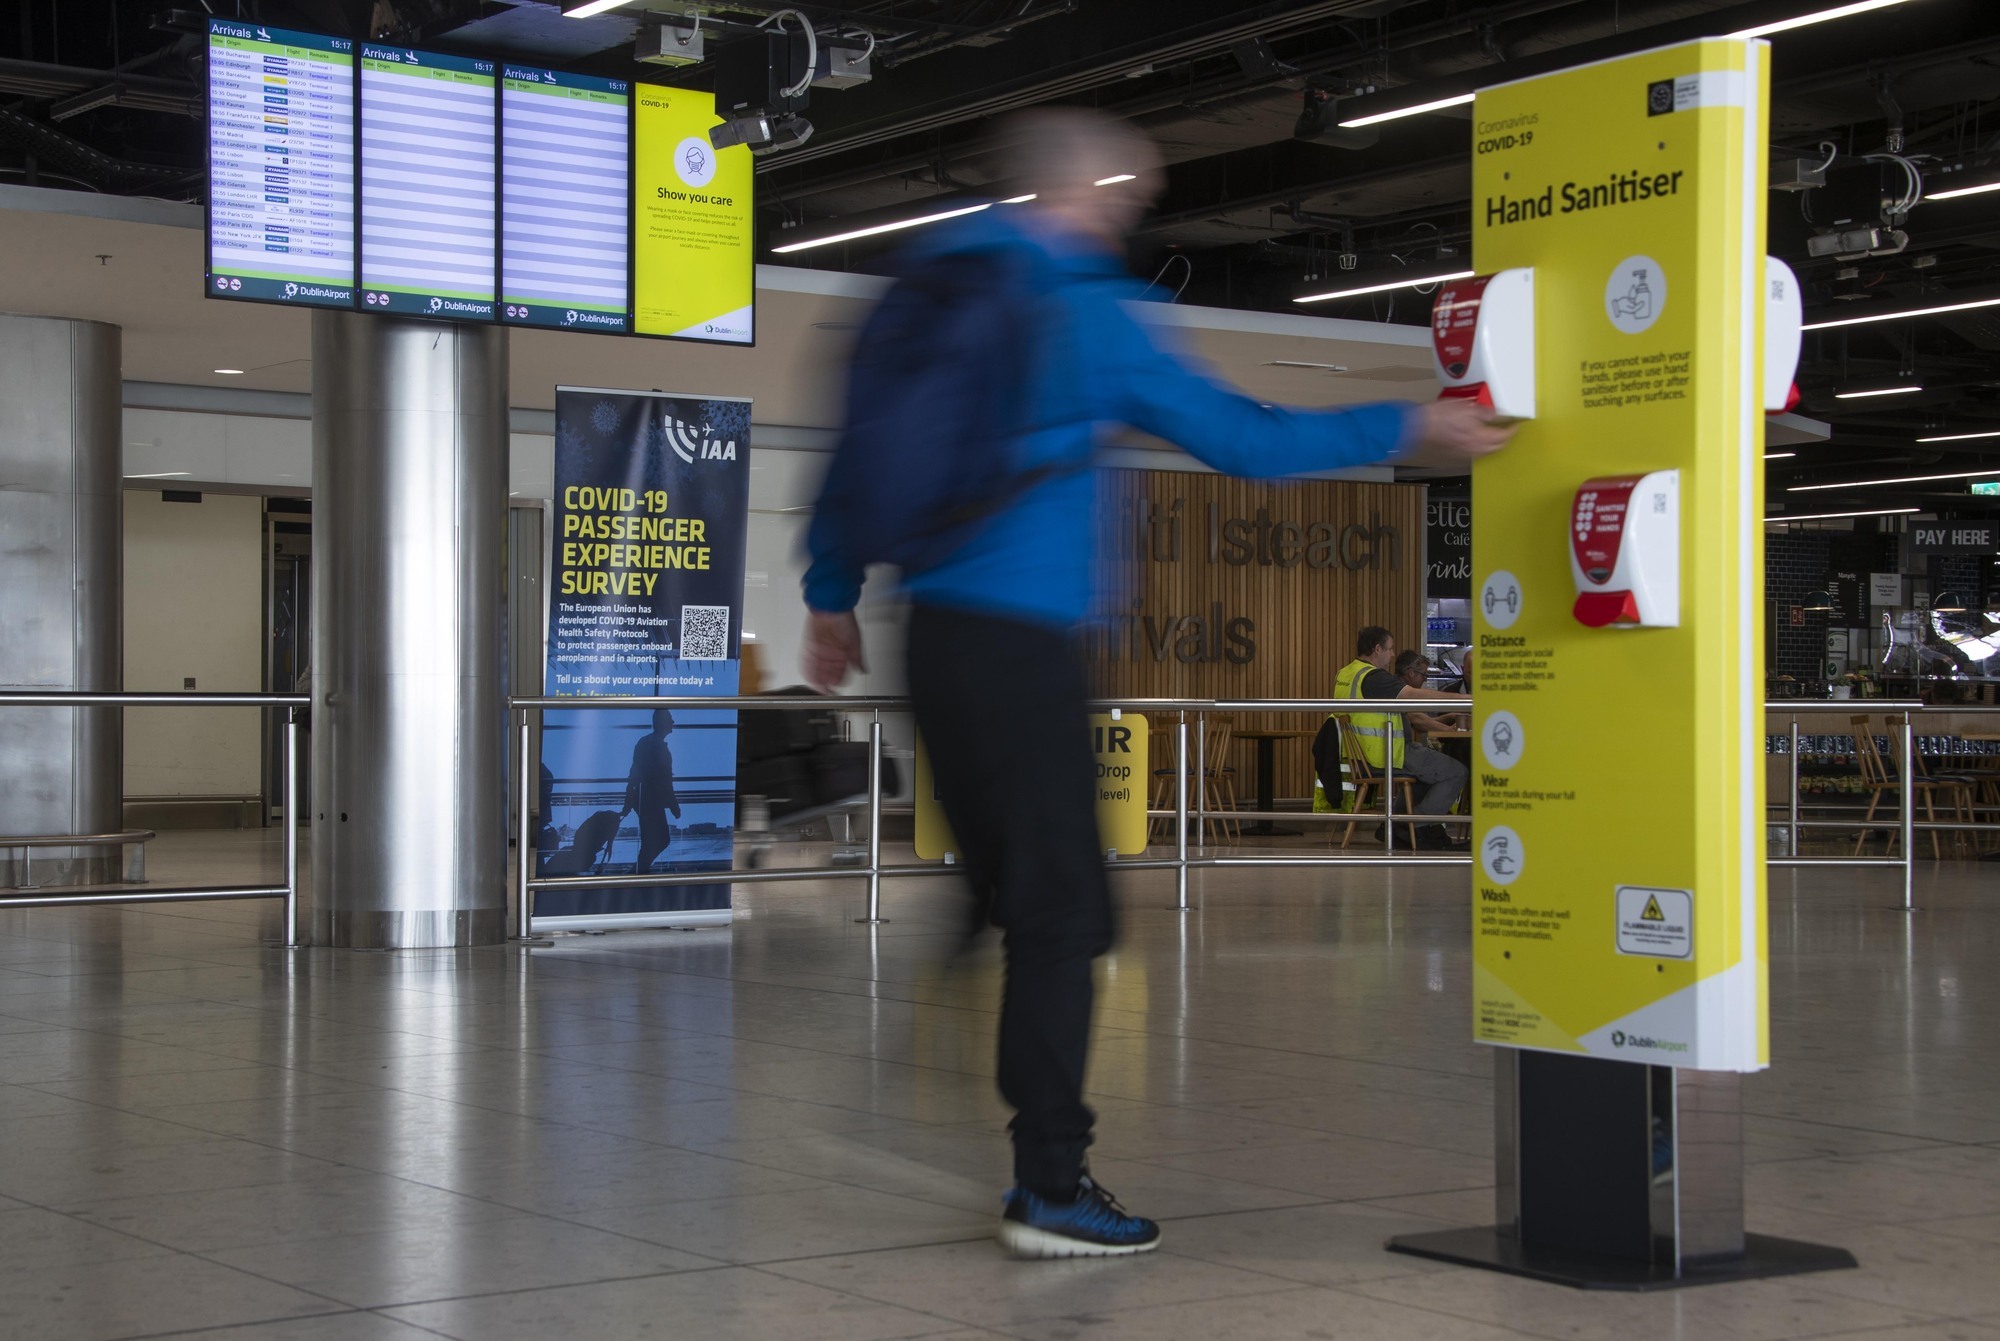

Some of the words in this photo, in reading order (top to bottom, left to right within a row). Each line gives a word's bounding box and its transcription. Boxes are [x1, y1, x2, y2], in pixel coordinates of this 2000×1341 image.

[211, 24, 252, 39] Arrivals
[331, 40, 352, 50] 15:17
[363, 48, 401, 61] Arrivals
[226, 60, 251, 70] Edinburgh
[474, 62, 493, 72] 15:17
[226, 71, 251, 80] Barcelona
[504, 68, 540, 82] Arrivals
[226, 81, 240, 89] Kerry
[608, 82, 627, 91] 15:17
[640, 99, 670, 109] COVID-19
[1477, 113, 1540, 135] Coronavirus
[1477, 131, 1534, 155] COVID-19
[657, 187, 686, 201] Show
[689, 193, 708, 204] you
[710, 195, 733, 206] care
[1486, 185, 1553, 228] Hand
[1560, 169, 1684, 213] Sanitiser
[300, 286, 350, 300] DublinAirport
[444, 301, 491, 314] DublinAirport
[579, 313, 623, 326] DublinAirport
[1589, 362, 1606, 372] you
[1607, 356, 1640, 368] cannot
[1641, 352, 1666, 364] wash
[1667, 351, 1691, 362] your
[1612, 369, 1642, 380] please
[1644, 367, 1662, 377] use
[1663, 362, 1689, 374] hand
[1582, 384, 1618, 396] sanitiser
[1620, 380, 1651, 392] before
[1652, 380, 1664, 388] or
[1665, 376, 1689, 387] after
[1583, 396, 1623, 408] touching
[1625, 395, 1642, 404] any
[701, 440, 737, 460] IAA
[564, 486, 668, 513] COVID-19
[1427, 501, 1470, 528] ette
[563, 514, 706, 542] PASSENGER
[1207, 500, 1400, 571] Isteach
[1444, 531, 1470, 546] Café
[1915, 530, 1946, 545] PAY
[1951, 529, 1990, 545] HERE
[562, 542, 711, 570] EXPERIENCE
[561, 570, 659, 596] SURVEY
[559, 603, 574, 612] The
[575, 603, 612, 616] European
[613, 604, 637, 613] Union
[638, 604, 652, 613] has
[558, 615, 597, 627] developed
[599, 616, 635, 626] COVID-19
[636, 617, 668, 626] Aviation
[558, 628, 583, 637] Health
[584, 628, 610, 639] Safety
[613, 629, 649, 638] Protocols
[557, 641, 566, 649] to
[567, 641, 595, 651] protect
[596, 643, 640, 653] passengers
[641, 642, 673, 651] onboard
[1480, 634, 1526, 648] Distance
[556, 654, 599, 663] aeroplanes
[600, 654, 616, 662] and
[617, 654, 625, 662] in
[626, 654, 658, 665] airports.
[556, 674, 571, 683] Tell
[572, 676, 582, 684] us
[584, 674, 610, 684] about
[612, 677, 632, 686] your
[633, 676, 678, 686] experience
[679, 675, 704, 687] today
[705, 676, 714, 685] at
[1096, 763, 1131, 781] Drop
[1481, 774, 1509, 787] Wear
[1099, 787, 1130, 803] level)
[1480, 888, 1511, 903] Wash
[1627, 1034, 1688, 1052] DublinAirport
